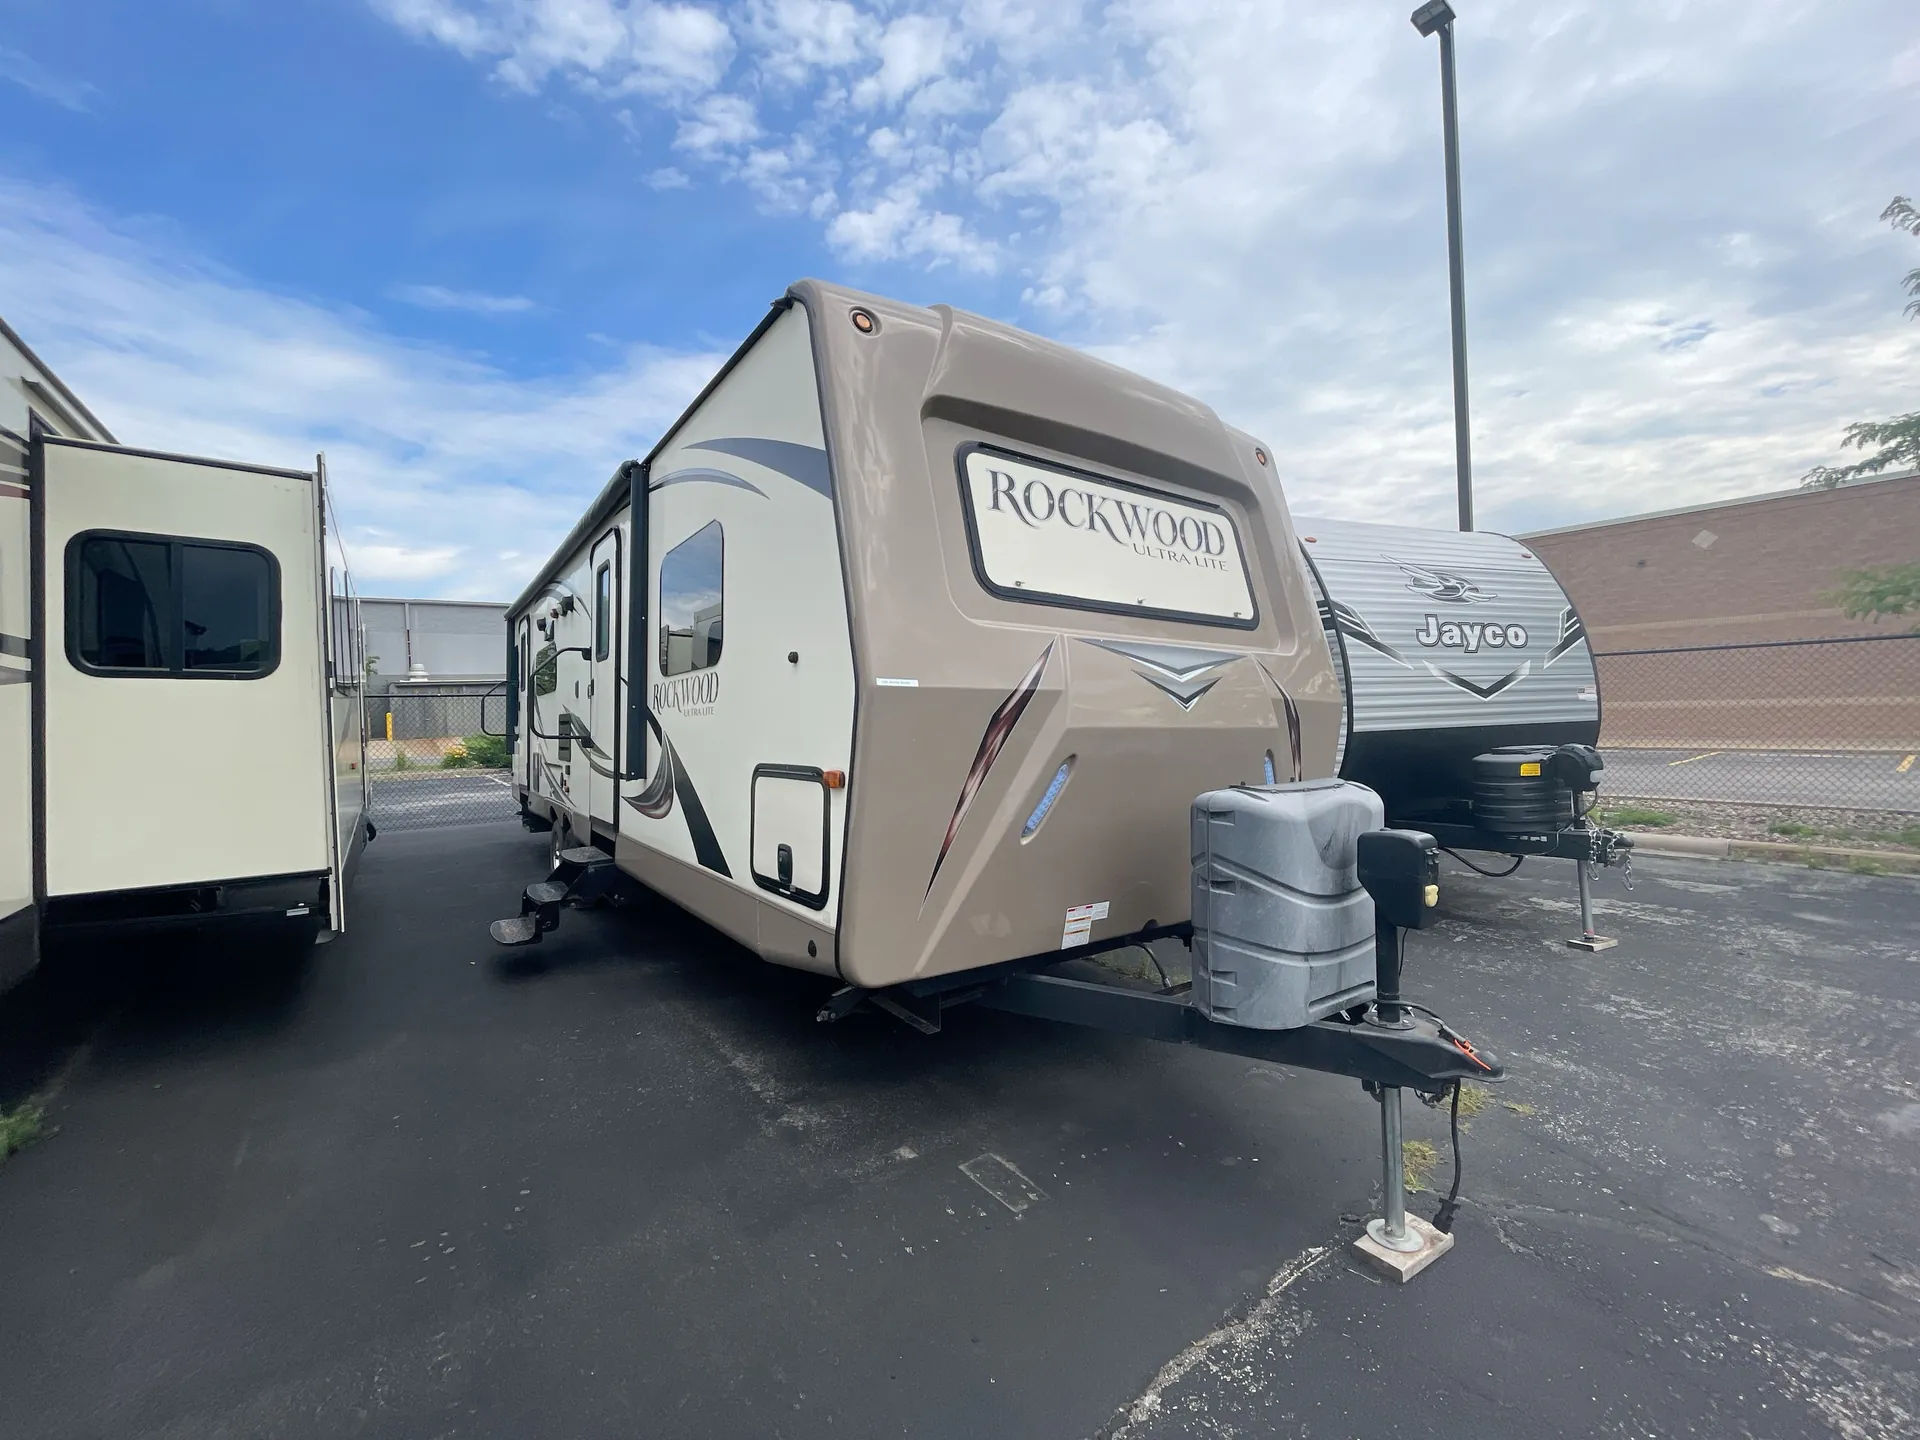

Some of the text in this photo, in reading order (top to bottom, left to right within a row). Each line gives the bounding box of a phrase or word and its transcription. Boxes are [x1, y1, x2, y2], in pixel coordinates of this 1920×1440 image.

[987, 468, 1226, 556] ROCKWOOD
[1133, 543, 1229, 572] ULTRA LITE
[1416, 614, 1528, 653] Jayco
[652, 671, 719, 714] ROCKWOOD
[683, 706, 715, 717] ULTRA LITE
